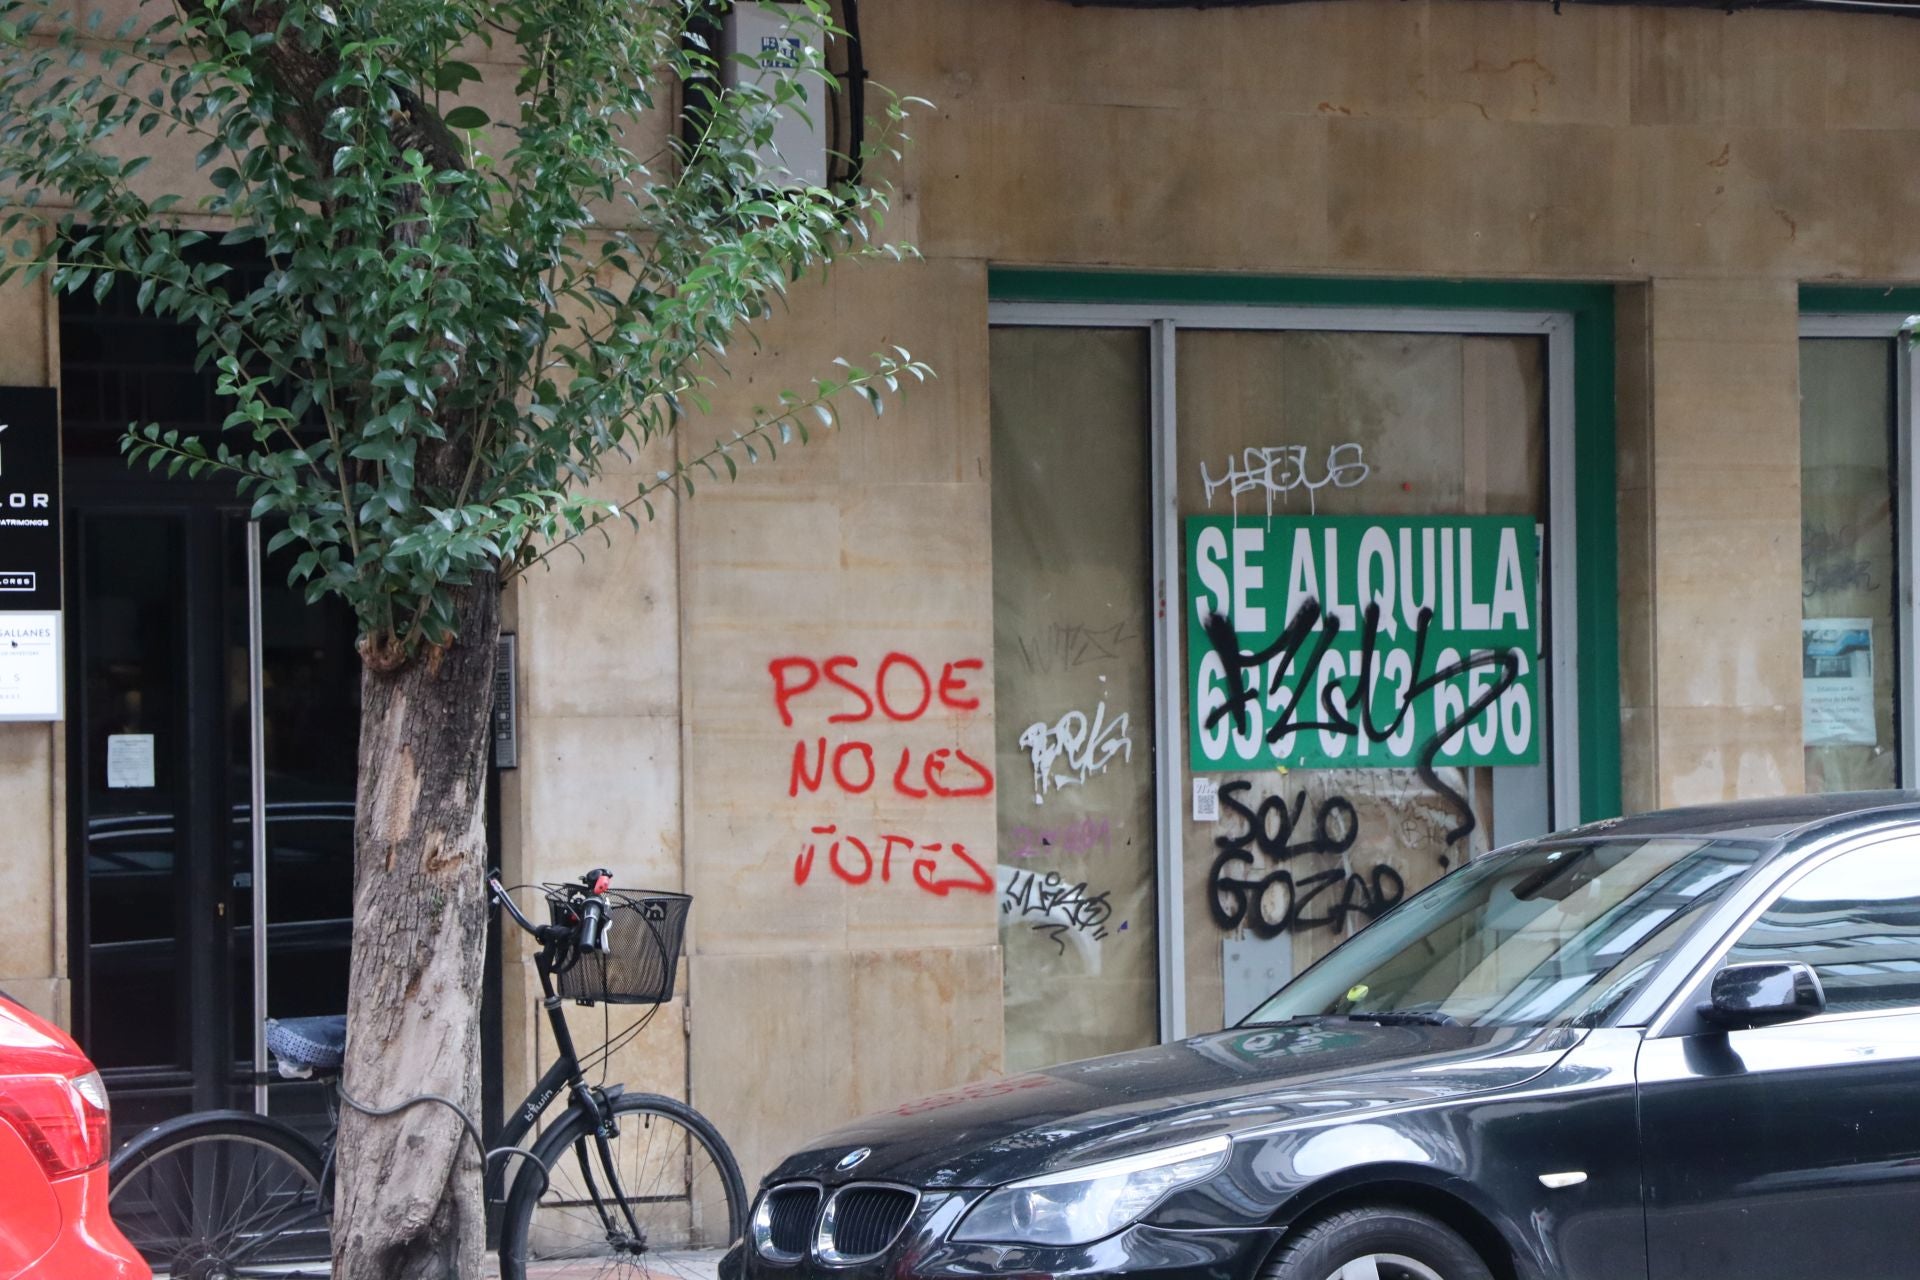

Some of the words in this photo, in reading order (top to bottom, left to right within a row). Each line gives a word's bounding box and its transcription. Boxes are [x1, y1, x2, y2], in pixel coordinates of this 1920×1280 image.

[0, 493, 49, 508] OR
[0, 518, 49, 526] ATRIMONIOS
[0, 577, 30, 585] ORES
[1195, 526, 1267, 632] SE
[1284, 526, 1530, 641] ALQUILA
[768, 651, 984, 728] PSOE
[1434, 646, 1532, 756] 656
[788, 736, 876, 798] NO
[893, 746, 995, 799] LES
